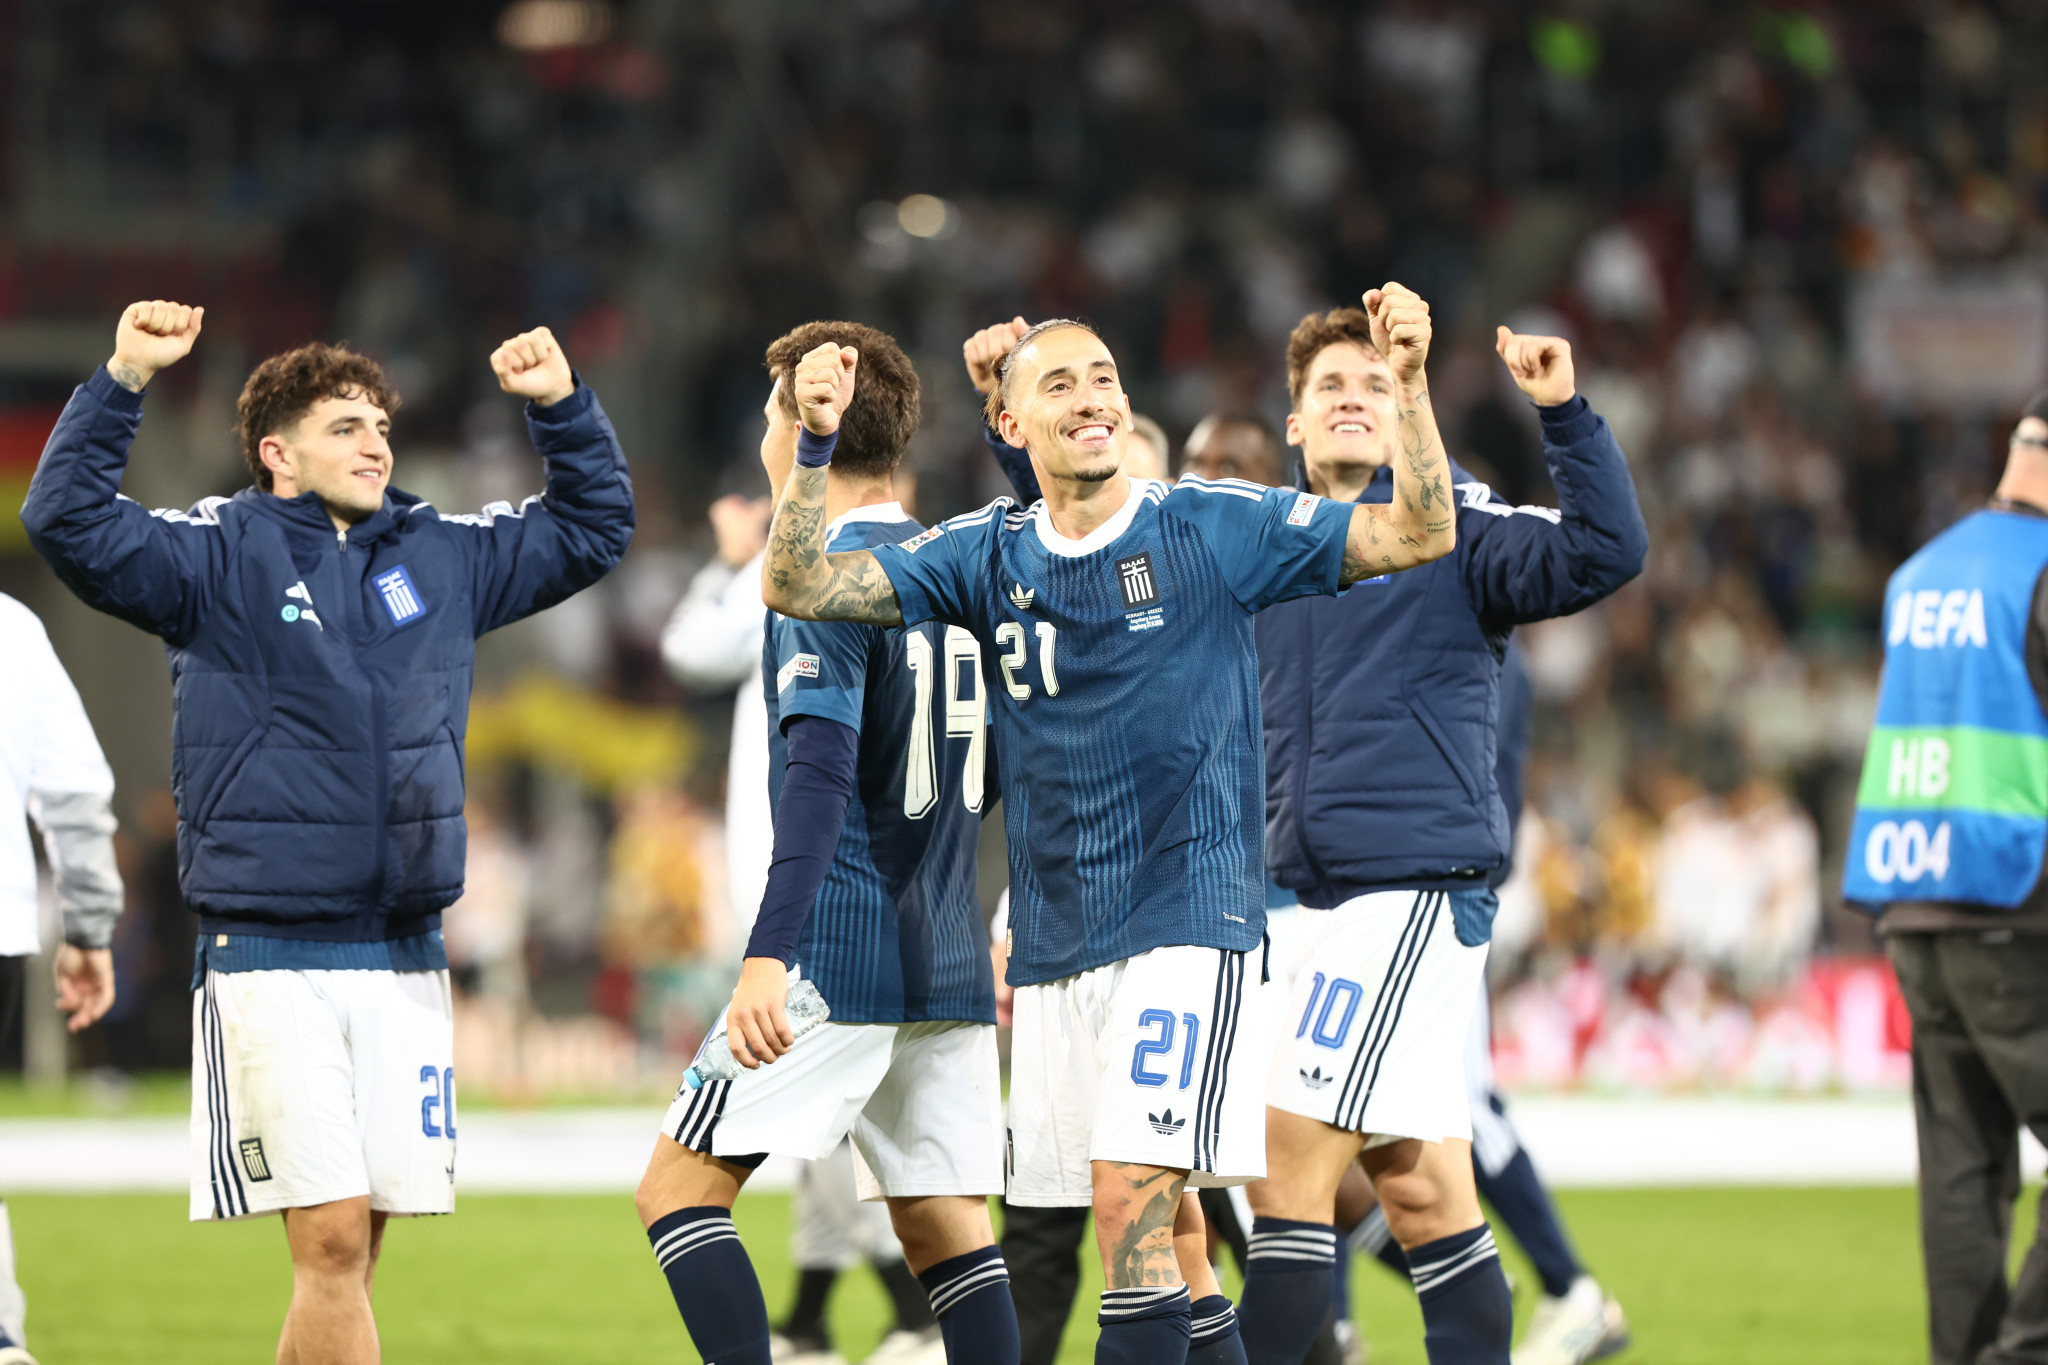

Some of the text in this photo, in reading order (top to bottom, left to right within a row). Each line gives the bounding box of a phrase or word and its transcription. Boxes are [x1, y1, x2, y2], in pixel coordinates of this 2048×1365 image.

[995, 622, 1060, 700] 21
[904, 624, 986, 820] 19
[1888, 737, 1951, 799] HB
[1864, 819, 1951, 884] 004
[1296, 971, 1364, 1050] 10
[1130, 1008, 1200, 1093] 21
